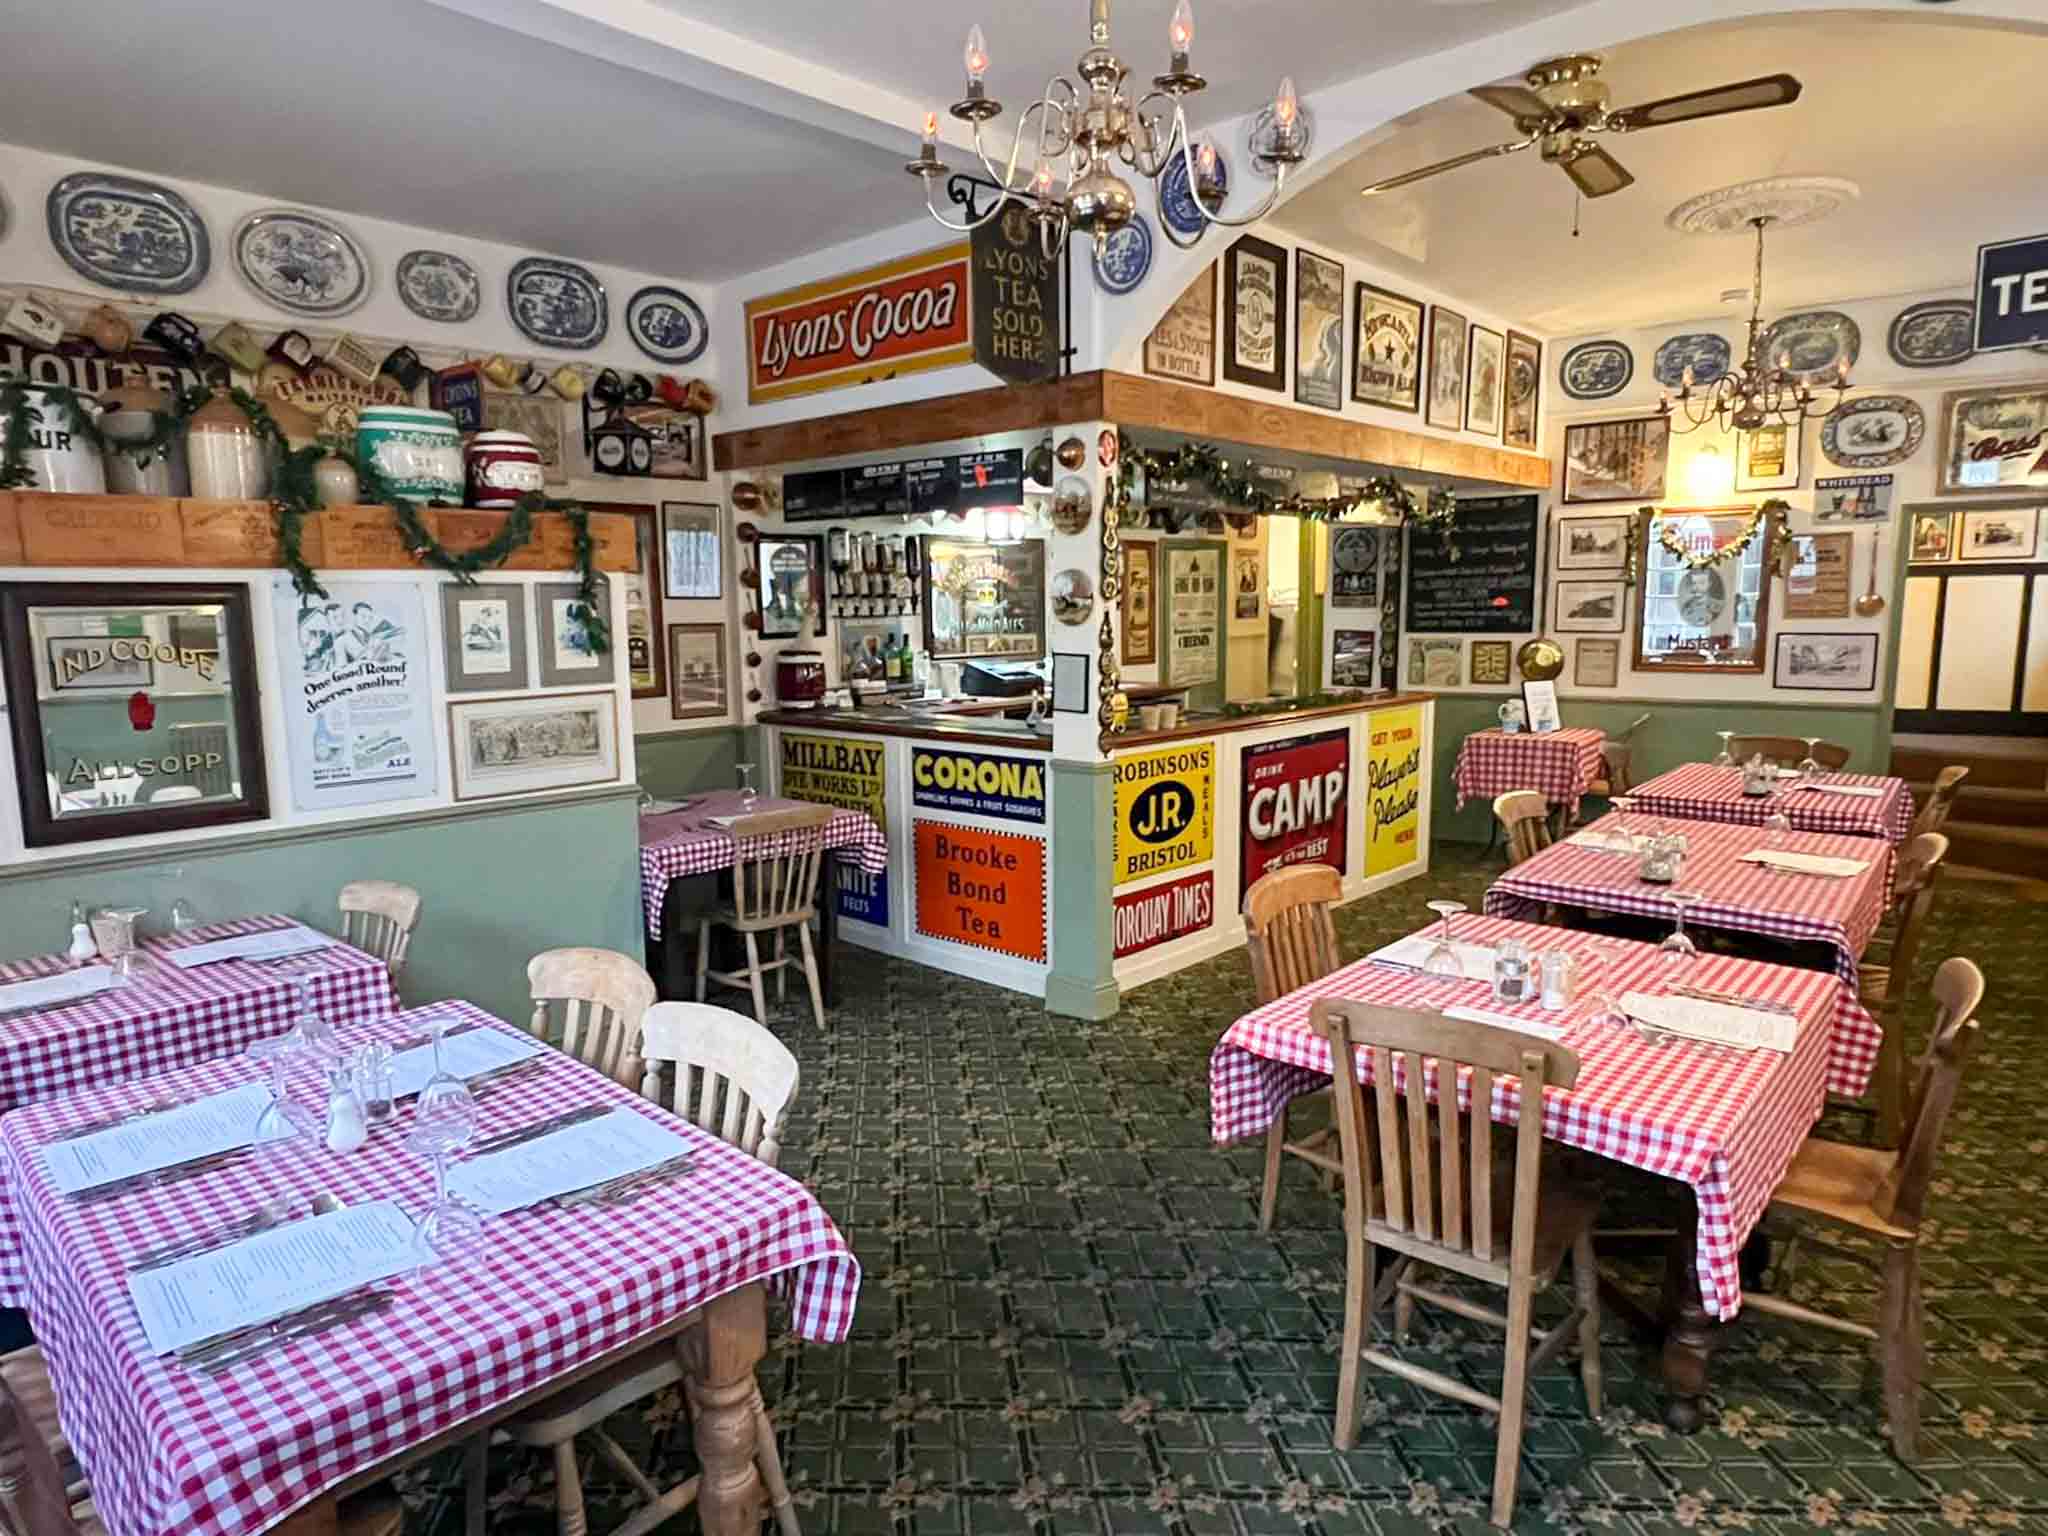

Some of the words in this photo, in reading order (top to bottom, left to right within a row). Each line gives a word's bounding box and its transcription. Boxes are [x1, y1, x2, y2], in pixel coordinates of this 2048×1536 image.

[993, 275, 1043, 313] TEA
[850, 280, 958, 358] Cocoa
[992, 306, 1043, 337] SOLD
[304, 679, 331, 696] One
[332, 664, 363, 682] Good
[365, 661, 407, 675] Round
[67, 751, 223, 784] ALLSOPP
[783, 740, 882, 777] MILLBAY
[1112, 750, 1210, 785] ROBINSONS
[1136, 790, 1186, 837] J.R.
[935, 832, 1018, 872] Brooke
[1127, 840, 1198, 875] BRISTOL
[947, 871, 1006, 905] Bond
[955, 905, 1002, 939] Tea
[1113, 891, 1171, 950] ORQUAY
[1172, 880, 1211, 931] TIMES
